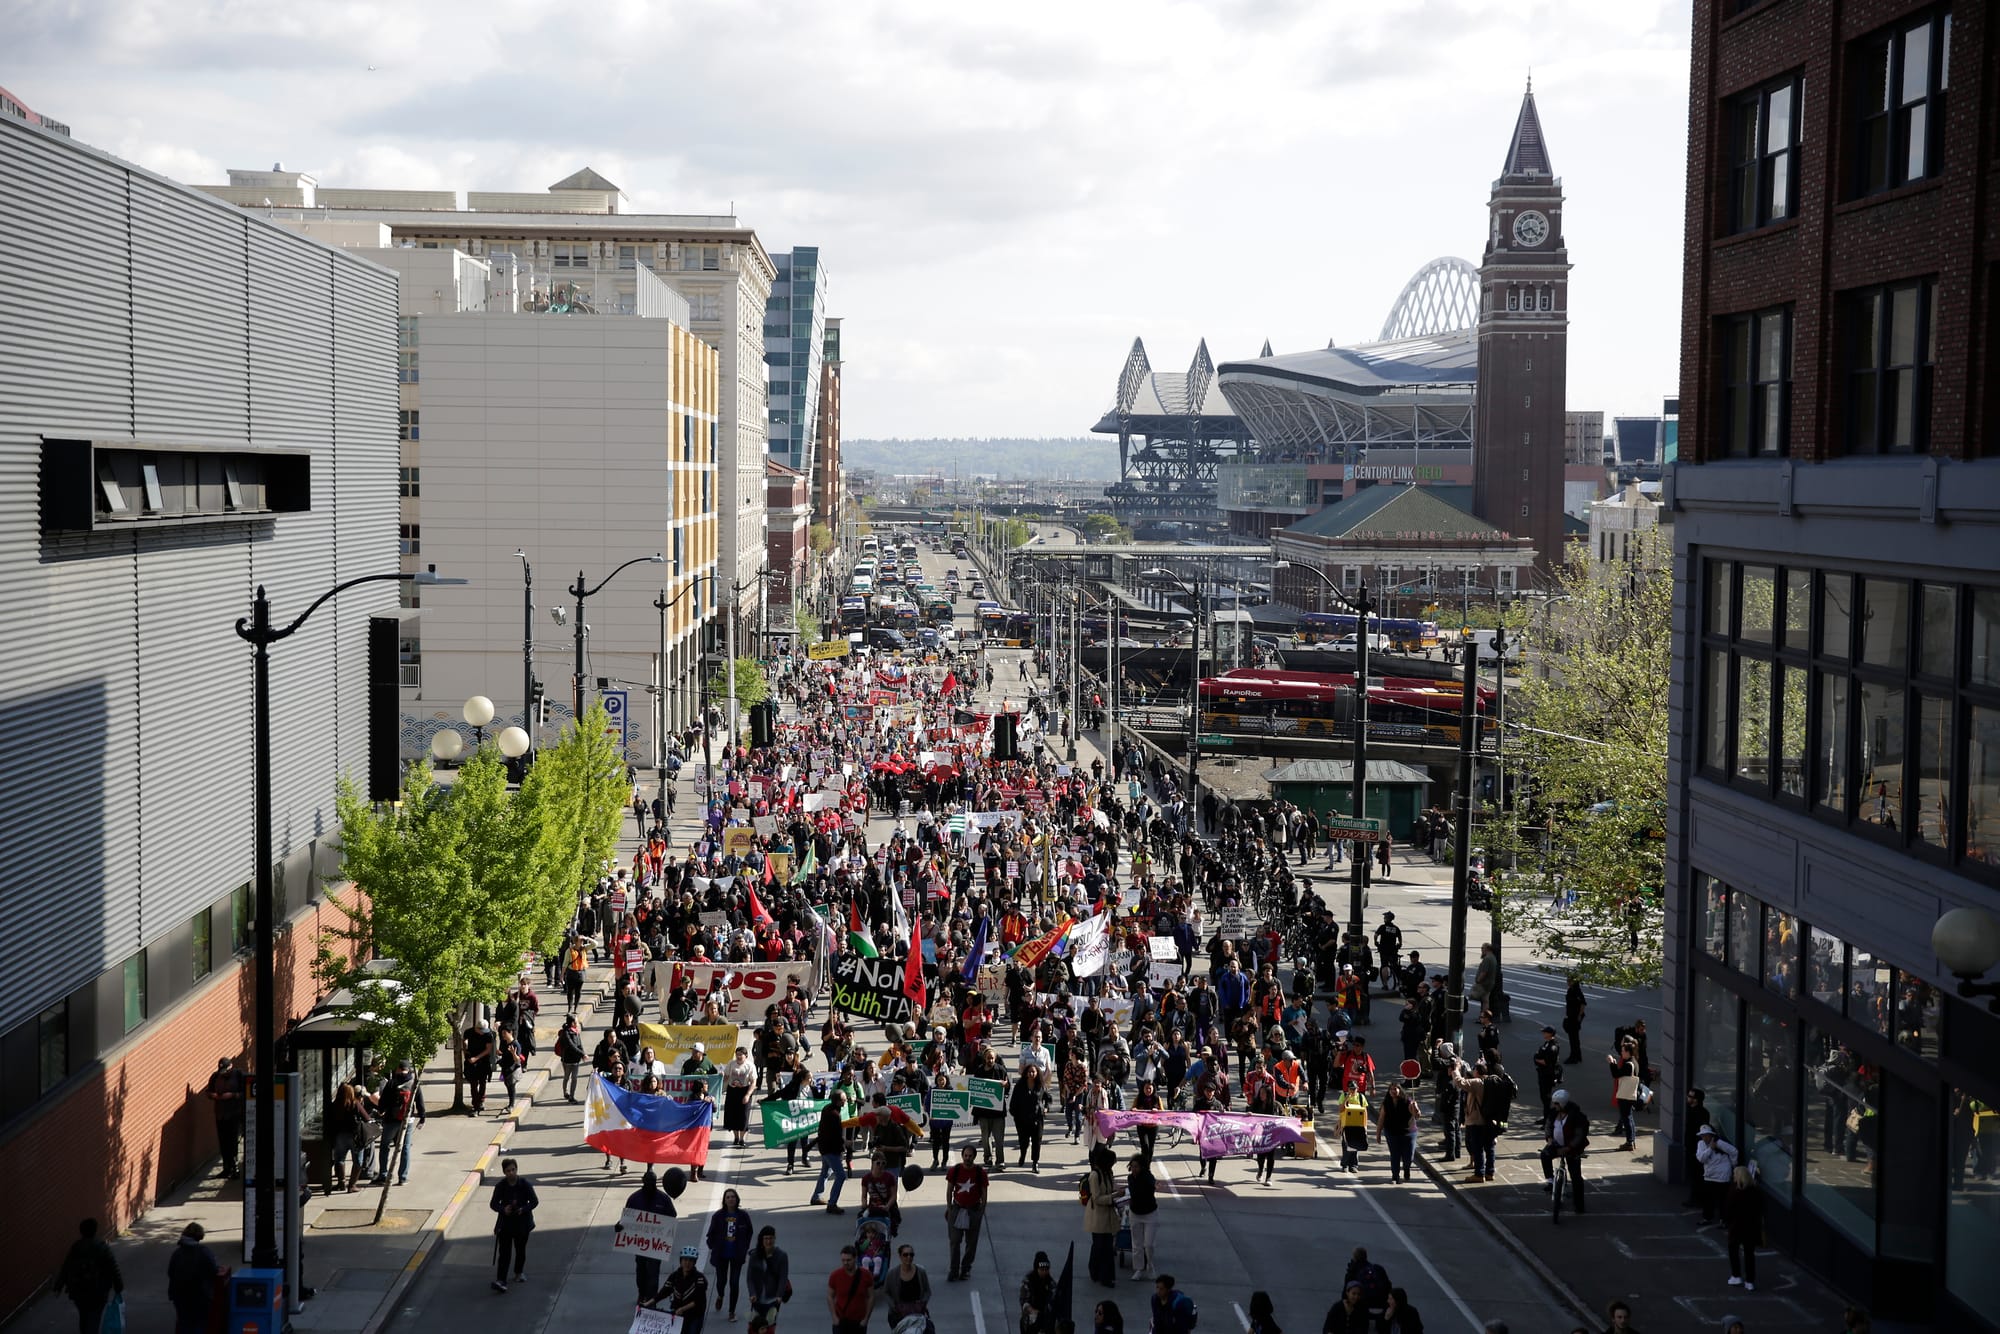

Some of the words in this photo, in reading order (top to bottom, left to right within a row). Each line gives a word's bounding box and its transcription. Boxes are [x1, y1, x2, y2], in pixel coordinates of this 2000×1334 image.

[1416, 464, 1443, 480] FIELD
[1352, 530, 1384, 539] KING
[1396, 531, 1443, 540] STREET
[1456, 531, 1510, 540] STATION
[1331, 817, 1366, 828] Prefontaine
[969, 1079, 987, 1087] DON'T
[969, 1085, 995, 1093] DISPLACE
[636, 1211, 662, 1225] ALL
